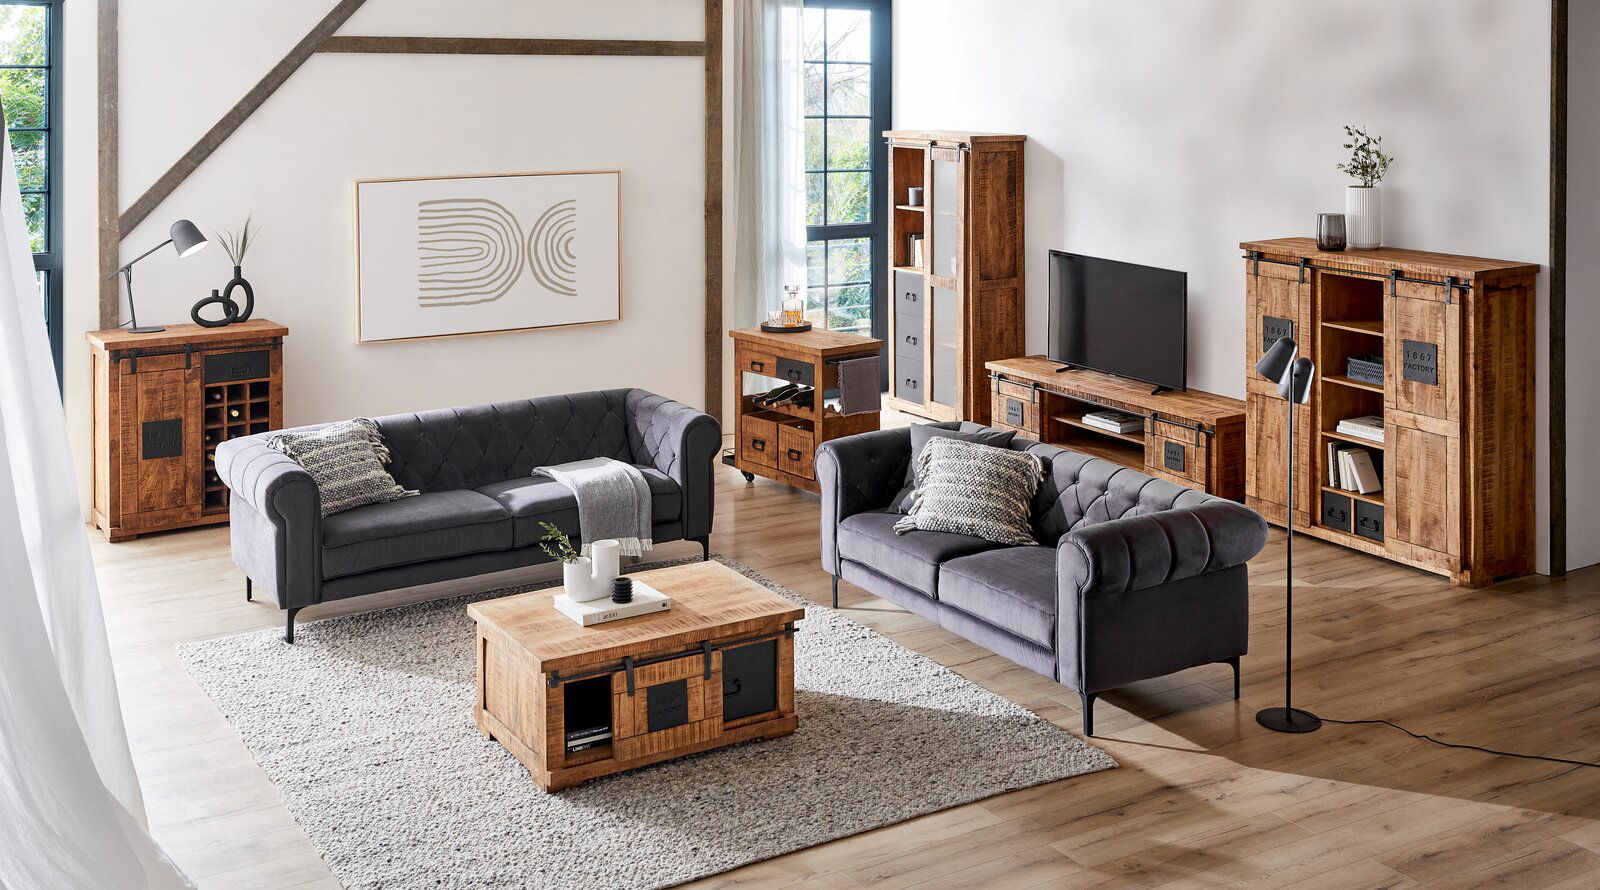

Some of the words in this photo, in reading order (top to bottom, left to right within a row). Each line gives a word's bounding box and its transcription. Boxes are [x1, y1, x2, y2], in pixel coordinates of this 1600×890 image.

[1265, 326, 1287, 336] 1867
[1406, 350, 1432, 362] 1867
[1403, 362, 1435, 374] FACTORY
